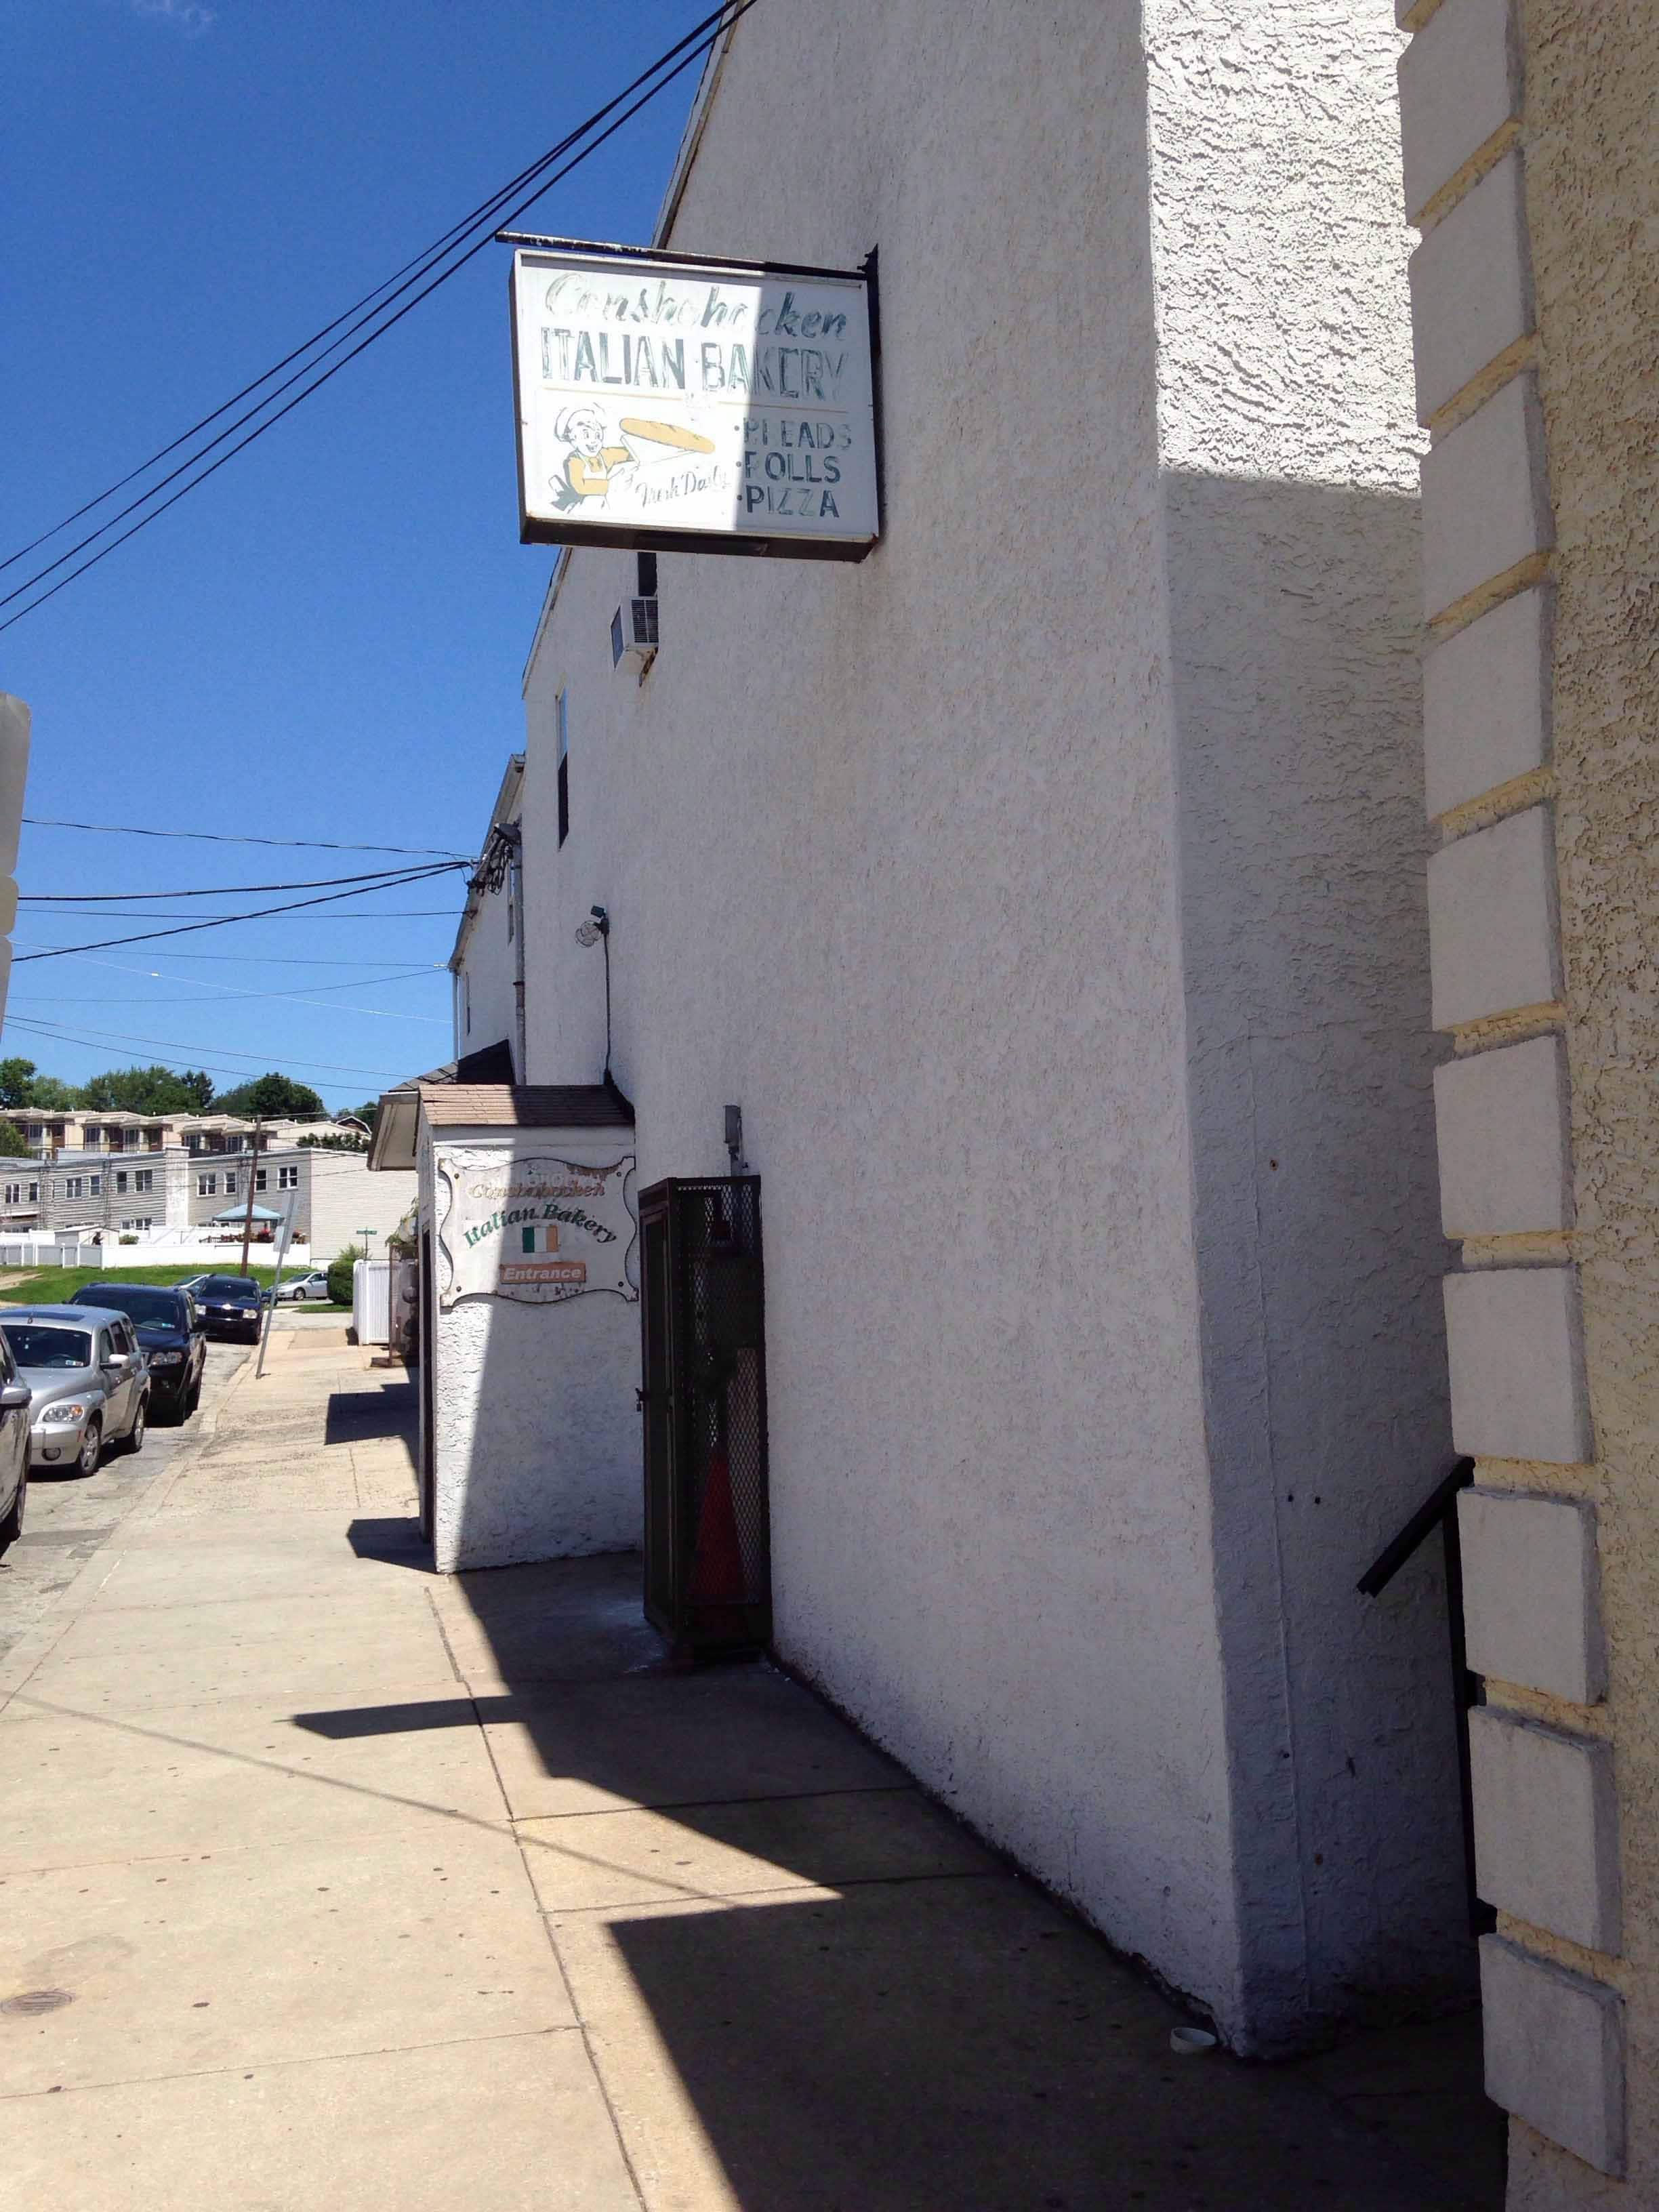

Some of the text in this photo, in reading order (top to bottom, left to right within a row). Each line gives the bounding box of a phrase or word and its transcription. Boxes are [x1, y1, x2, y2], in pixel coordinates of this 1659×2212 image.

[541, 327, 845, 400] ITALIAN BAKERY
[745, 485, 840, 518] PIZZA
[464, 1203, 617, 1248] Italian Bakery
[503, 1267, 582, 1280] Entrance
